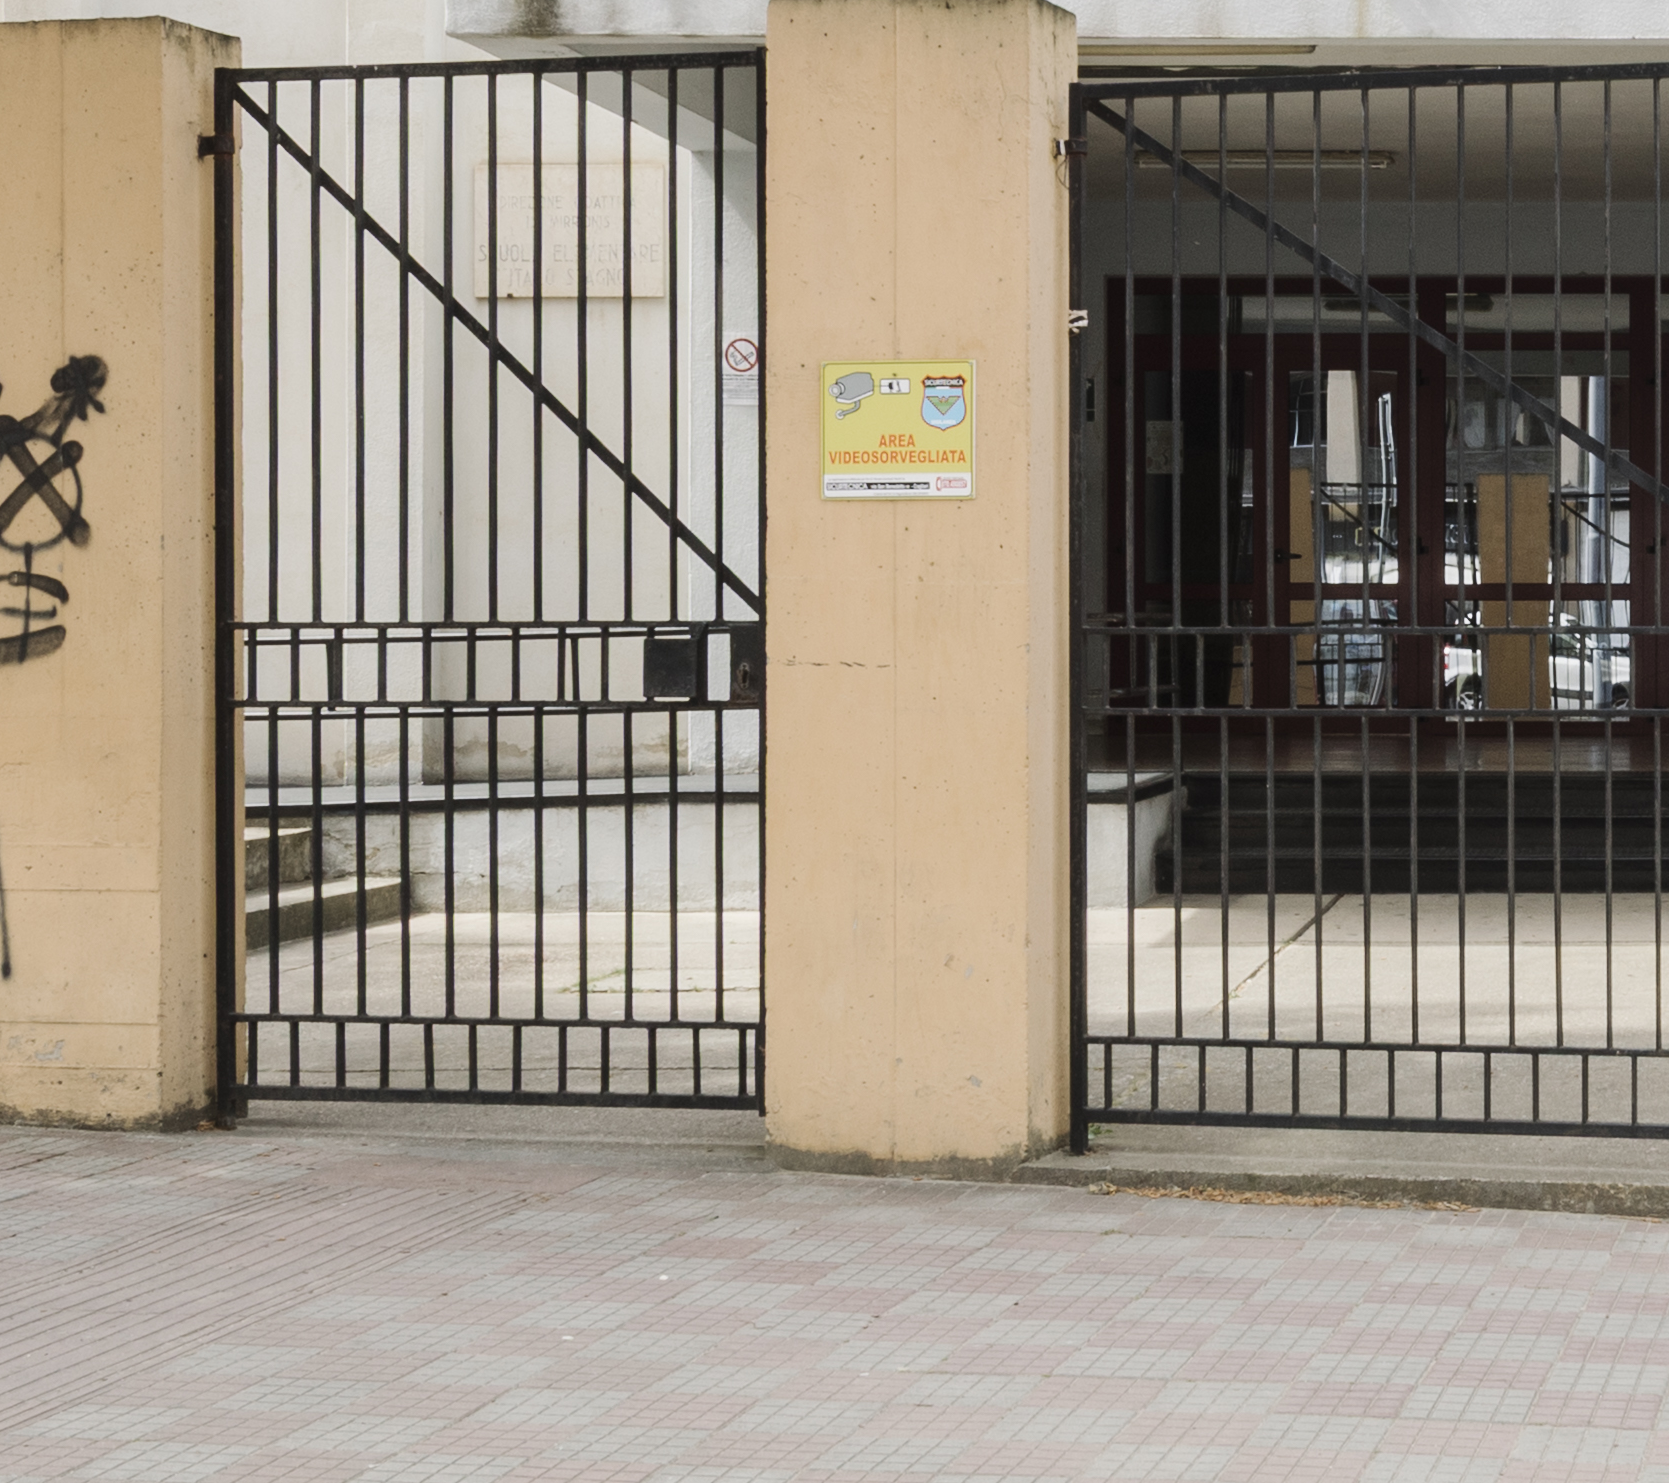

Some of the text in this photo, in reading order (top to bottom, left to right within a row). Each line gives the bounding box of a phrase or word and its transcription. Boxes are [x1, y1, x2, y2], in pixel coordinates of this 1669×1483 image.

[477, 244, 537, 262] SUOL
[878, 433, 916, 448] AREA
[828, 449, 967, 465] VIDEOSORVEGLIATA
